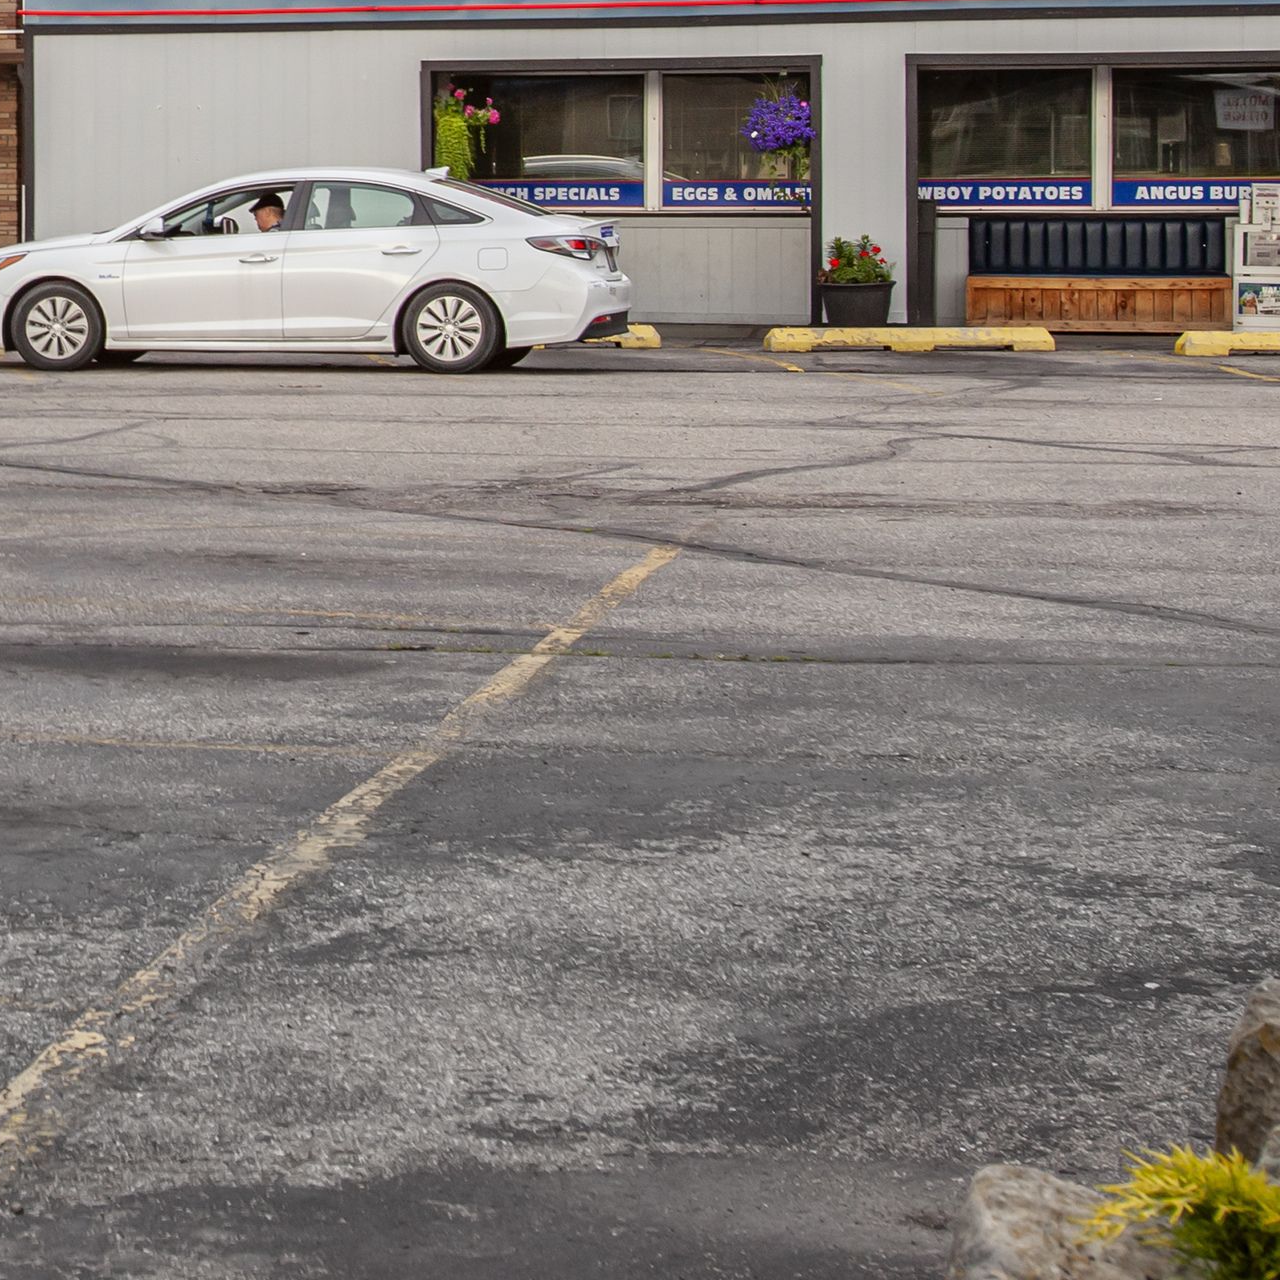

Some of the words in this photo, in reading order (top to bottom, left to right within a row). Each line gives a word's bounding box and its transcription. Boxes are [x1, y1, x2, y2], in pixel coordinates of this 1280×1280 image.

[533, 186, 621, 201] SPECIALS
[671, 186, 721, 201] EGGS
[723, 186, 738, 201] &
[978, 186, 1083, 200] POTATOES
[1134, 185, 1204, 200] ANGUS
